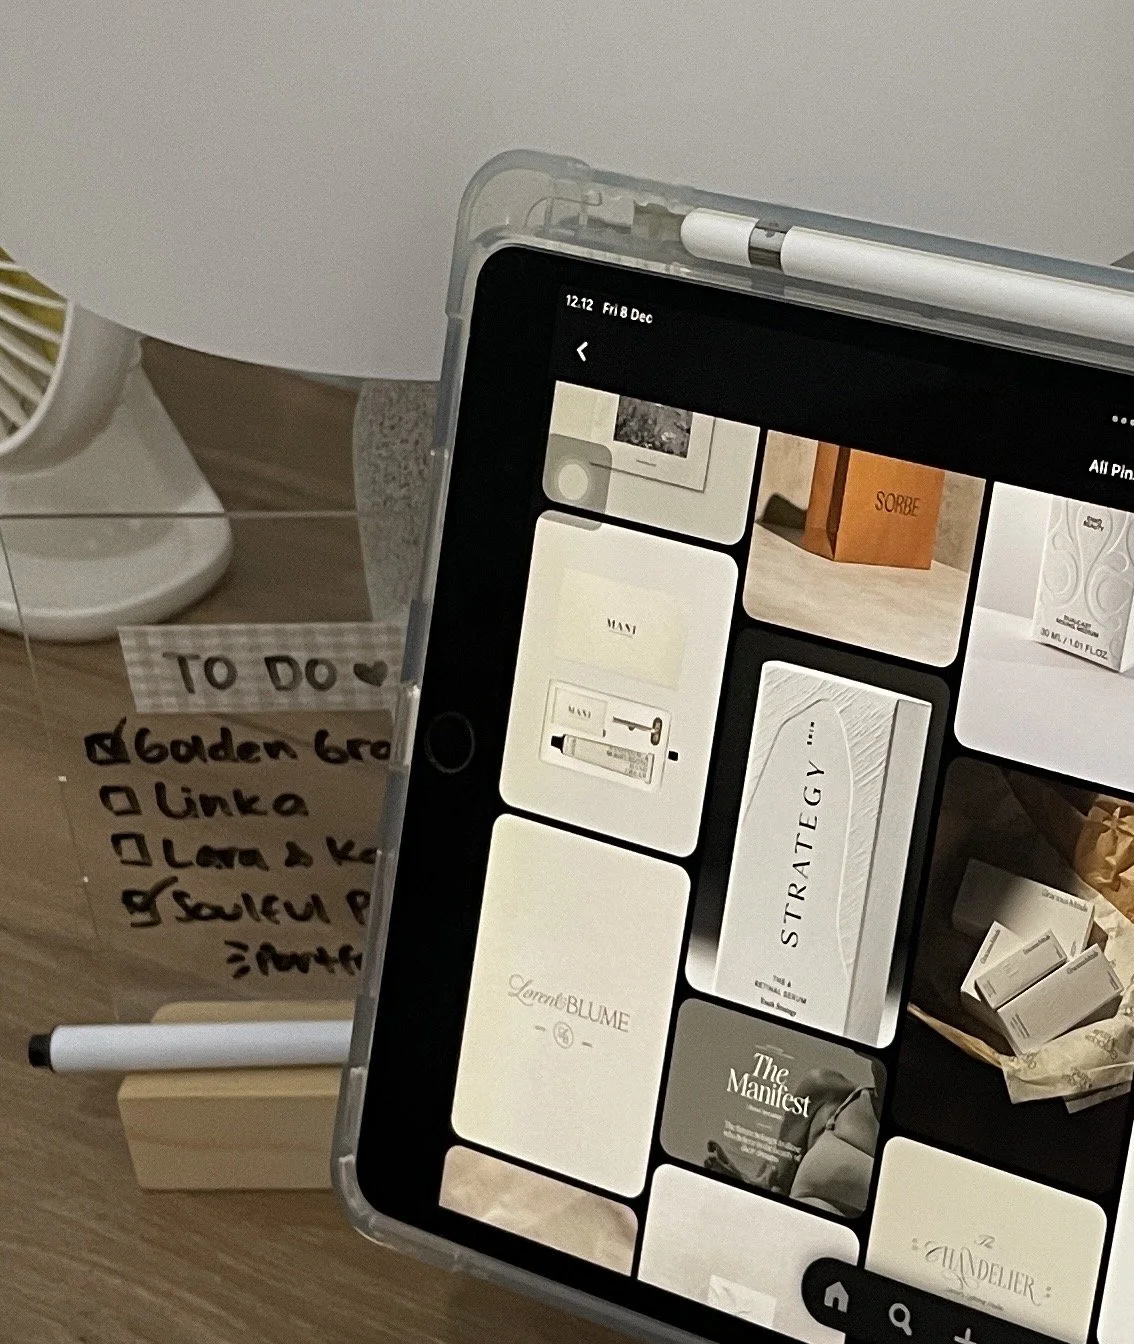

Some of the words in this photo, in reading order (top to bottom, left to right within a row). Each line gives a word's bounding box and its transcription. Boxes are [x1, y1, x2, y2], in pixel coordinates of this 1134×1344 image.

[602, 302, 618, 317] Fri
[619, 306, 628, 319] 8
[630, 308, 653, 324] Dec
[1089, 459, 1108, 475] All
[874, 490, 921, 517] SORBE
[163, 653, 237, 694] TO
[264, 655, 336, 692] DO
[780, 760, 826, 949] STRATEGY
[566, 994, 630, 1032] BLUME
[754, 1052, 790, 1085] The
[726, 1067, 812, 1118] Manifest
